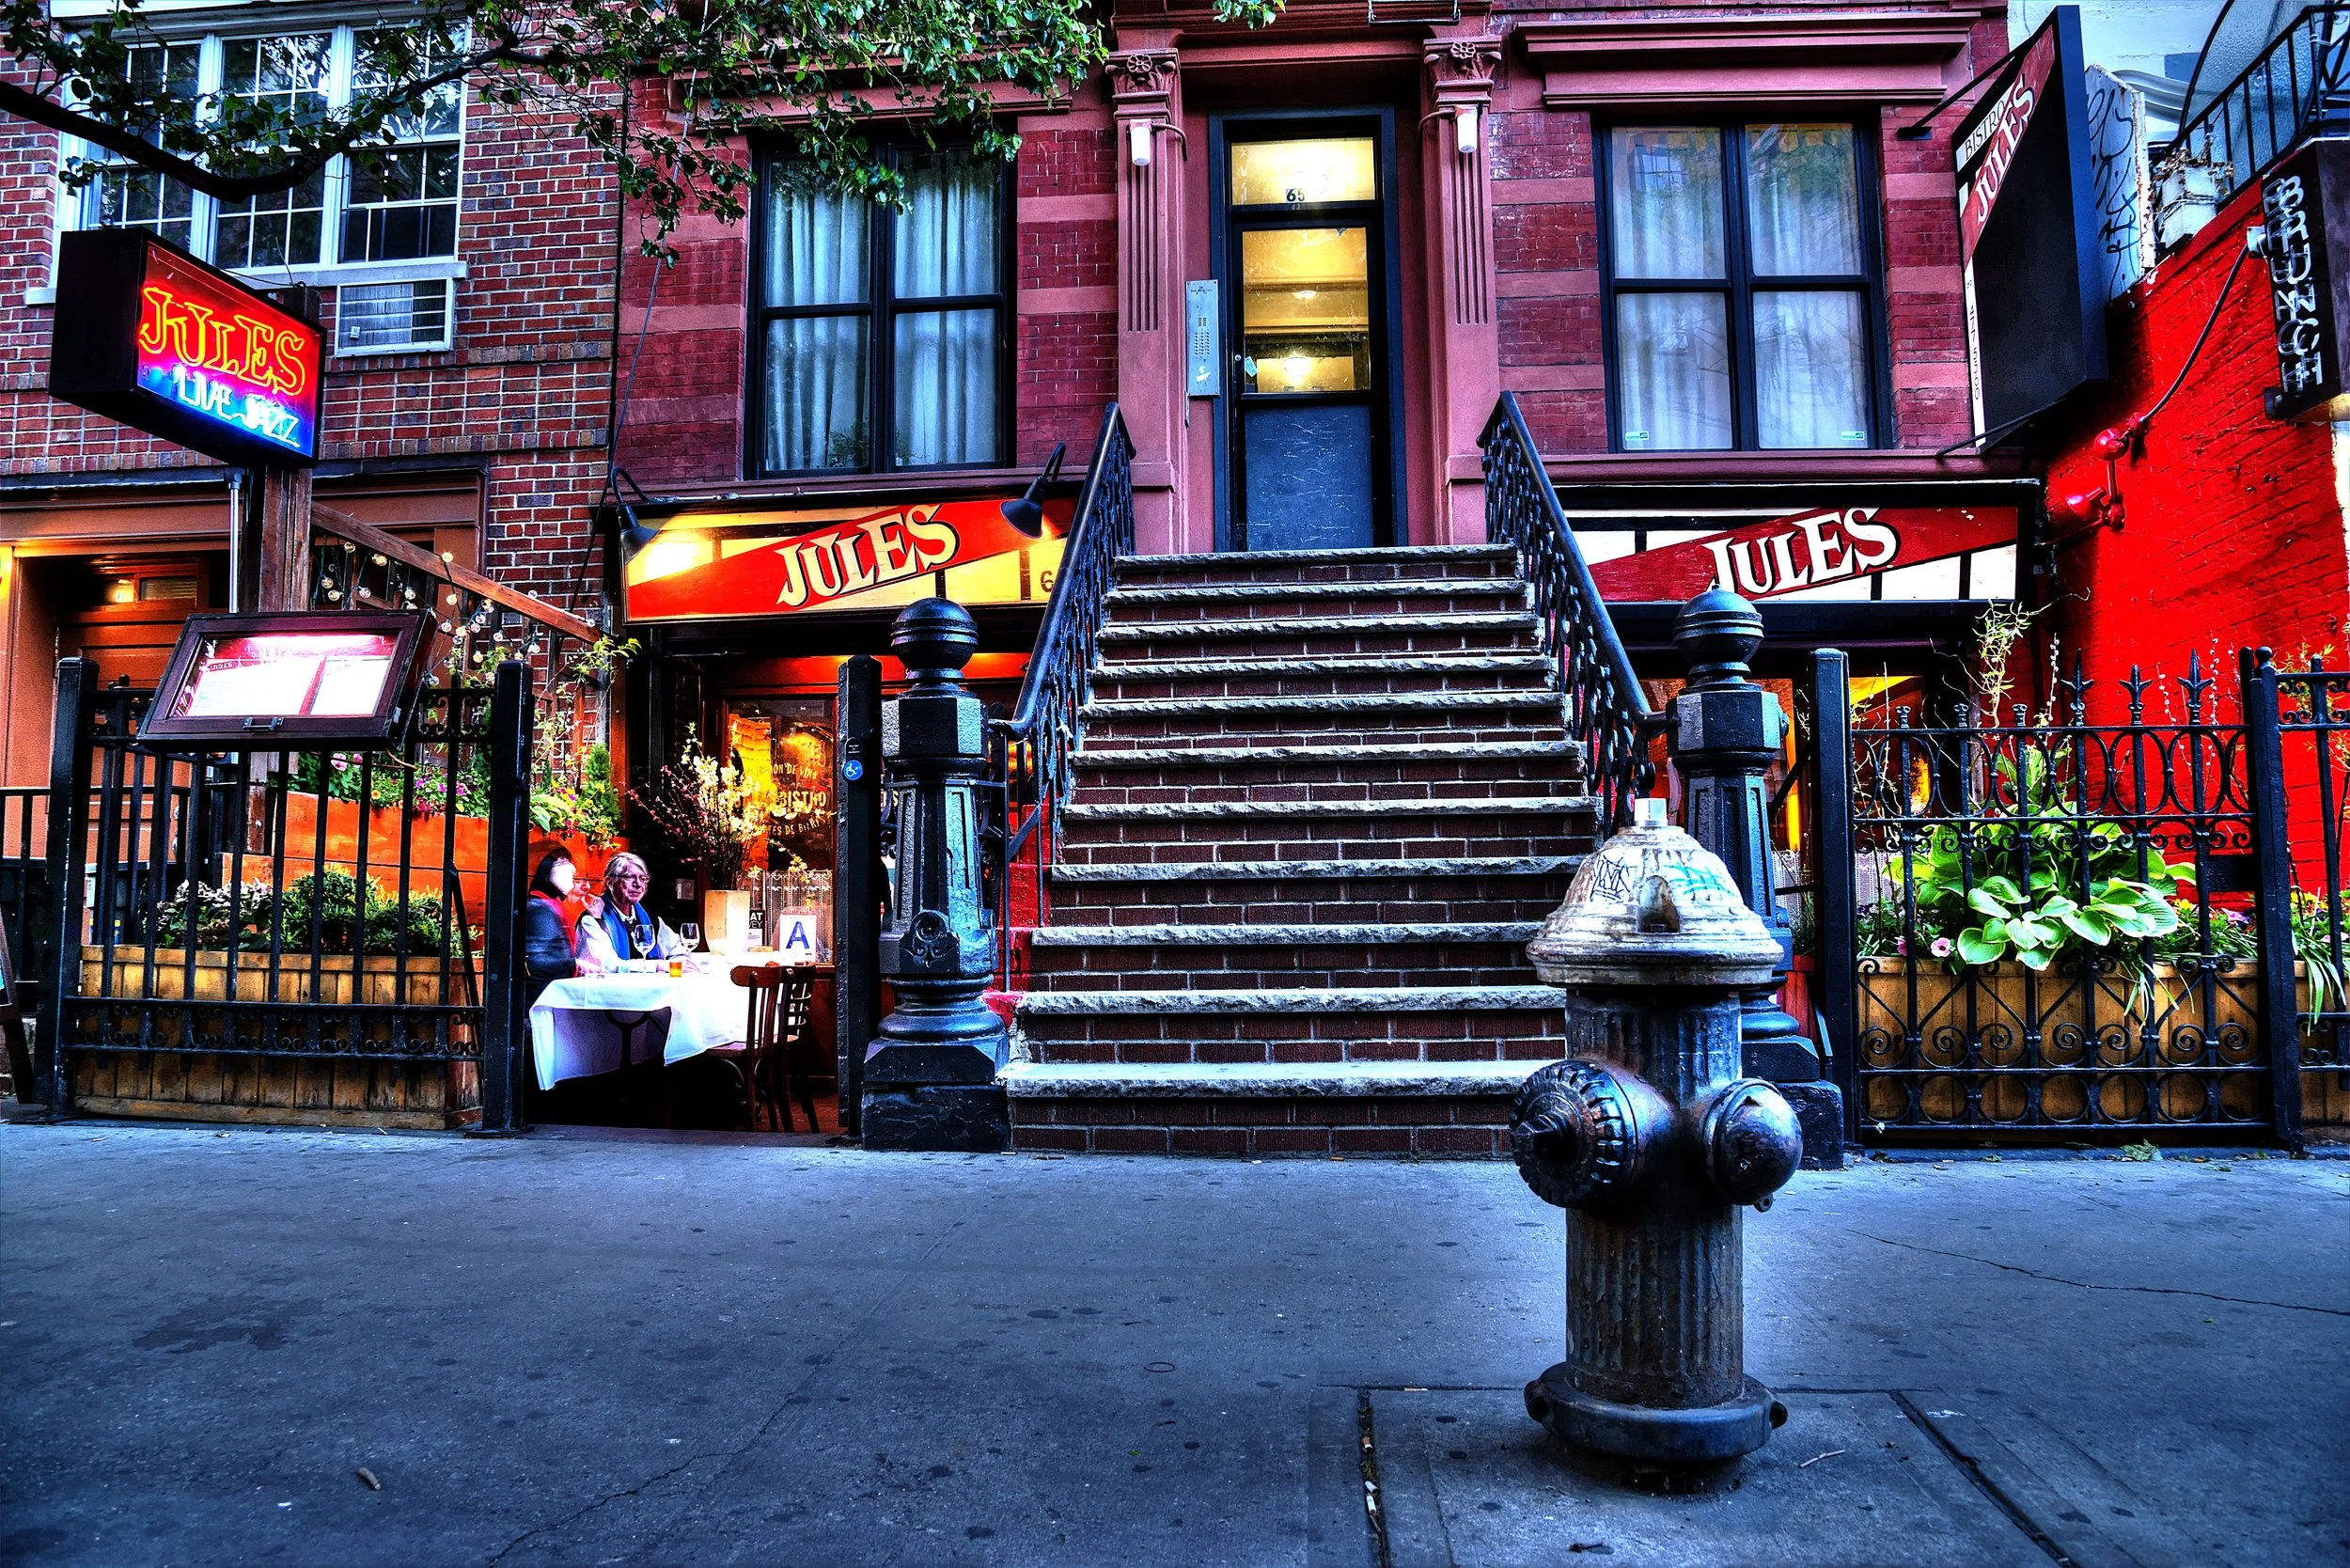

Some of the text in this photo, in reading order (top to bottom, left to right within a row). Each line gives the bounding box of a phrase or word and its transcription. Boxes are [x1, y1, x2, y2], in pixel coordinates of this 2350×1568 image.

[1964, 100, 2005, 162] BISTRO
[1975, 73, 2035, 225] JULES
[1286, 188, 1306, 202] 65
[139, 287, 306, 396] JULES
[773, 503, 960, 606] JULES
[1701, 507, 1901, 594] JULES
[786, 921, 809, 948] A
